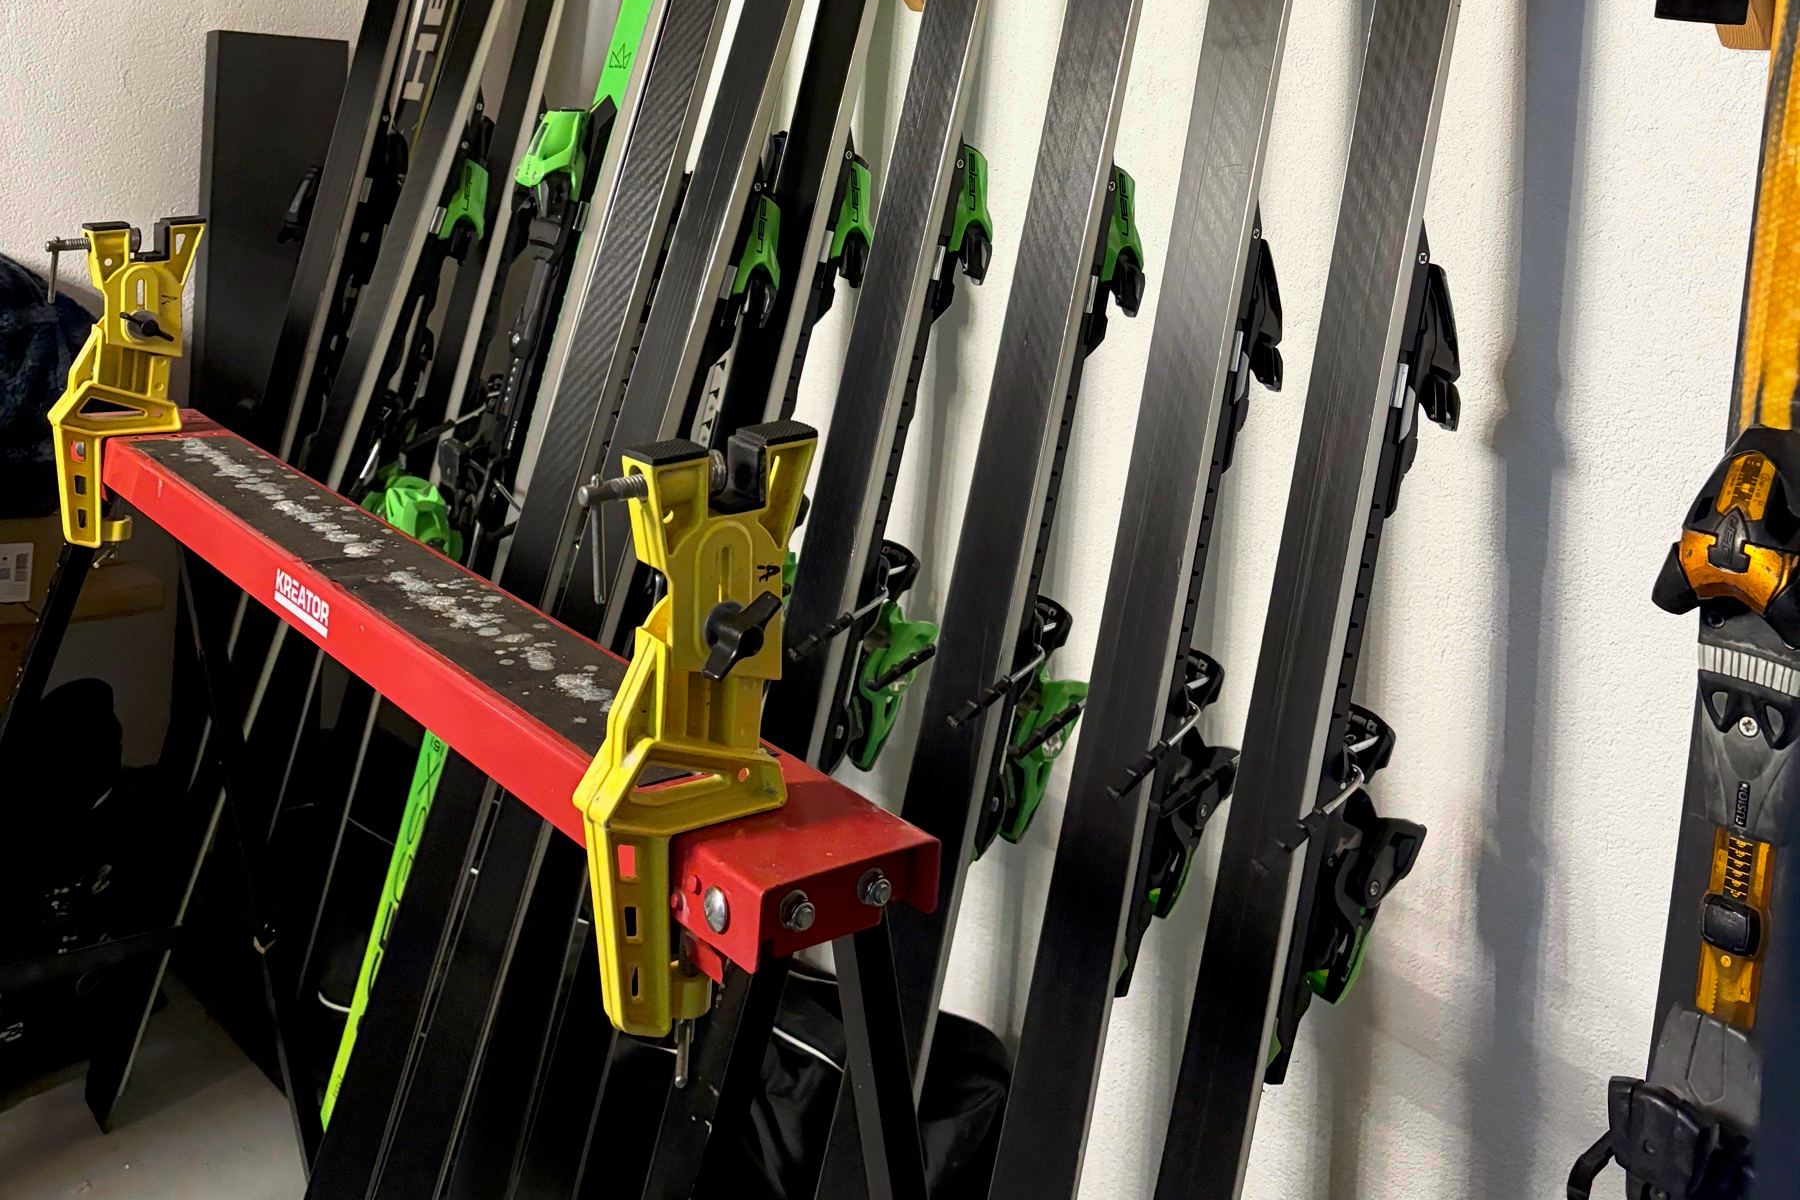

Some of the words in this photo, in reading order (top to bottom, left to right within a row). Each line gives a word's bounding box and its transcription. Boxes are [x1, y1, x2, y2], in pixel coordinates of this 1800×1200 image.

[462, 165, 473, 212] elan
[850, 167, 862, 223] elan
[967, 152, 976, 212] elan
[1118, 173, 1130, 237] elan
[755, 198, 768, 254] elan
[275, 567, 330, 627] KREATOR
[1735, 782, 1749, 825] FUSION
